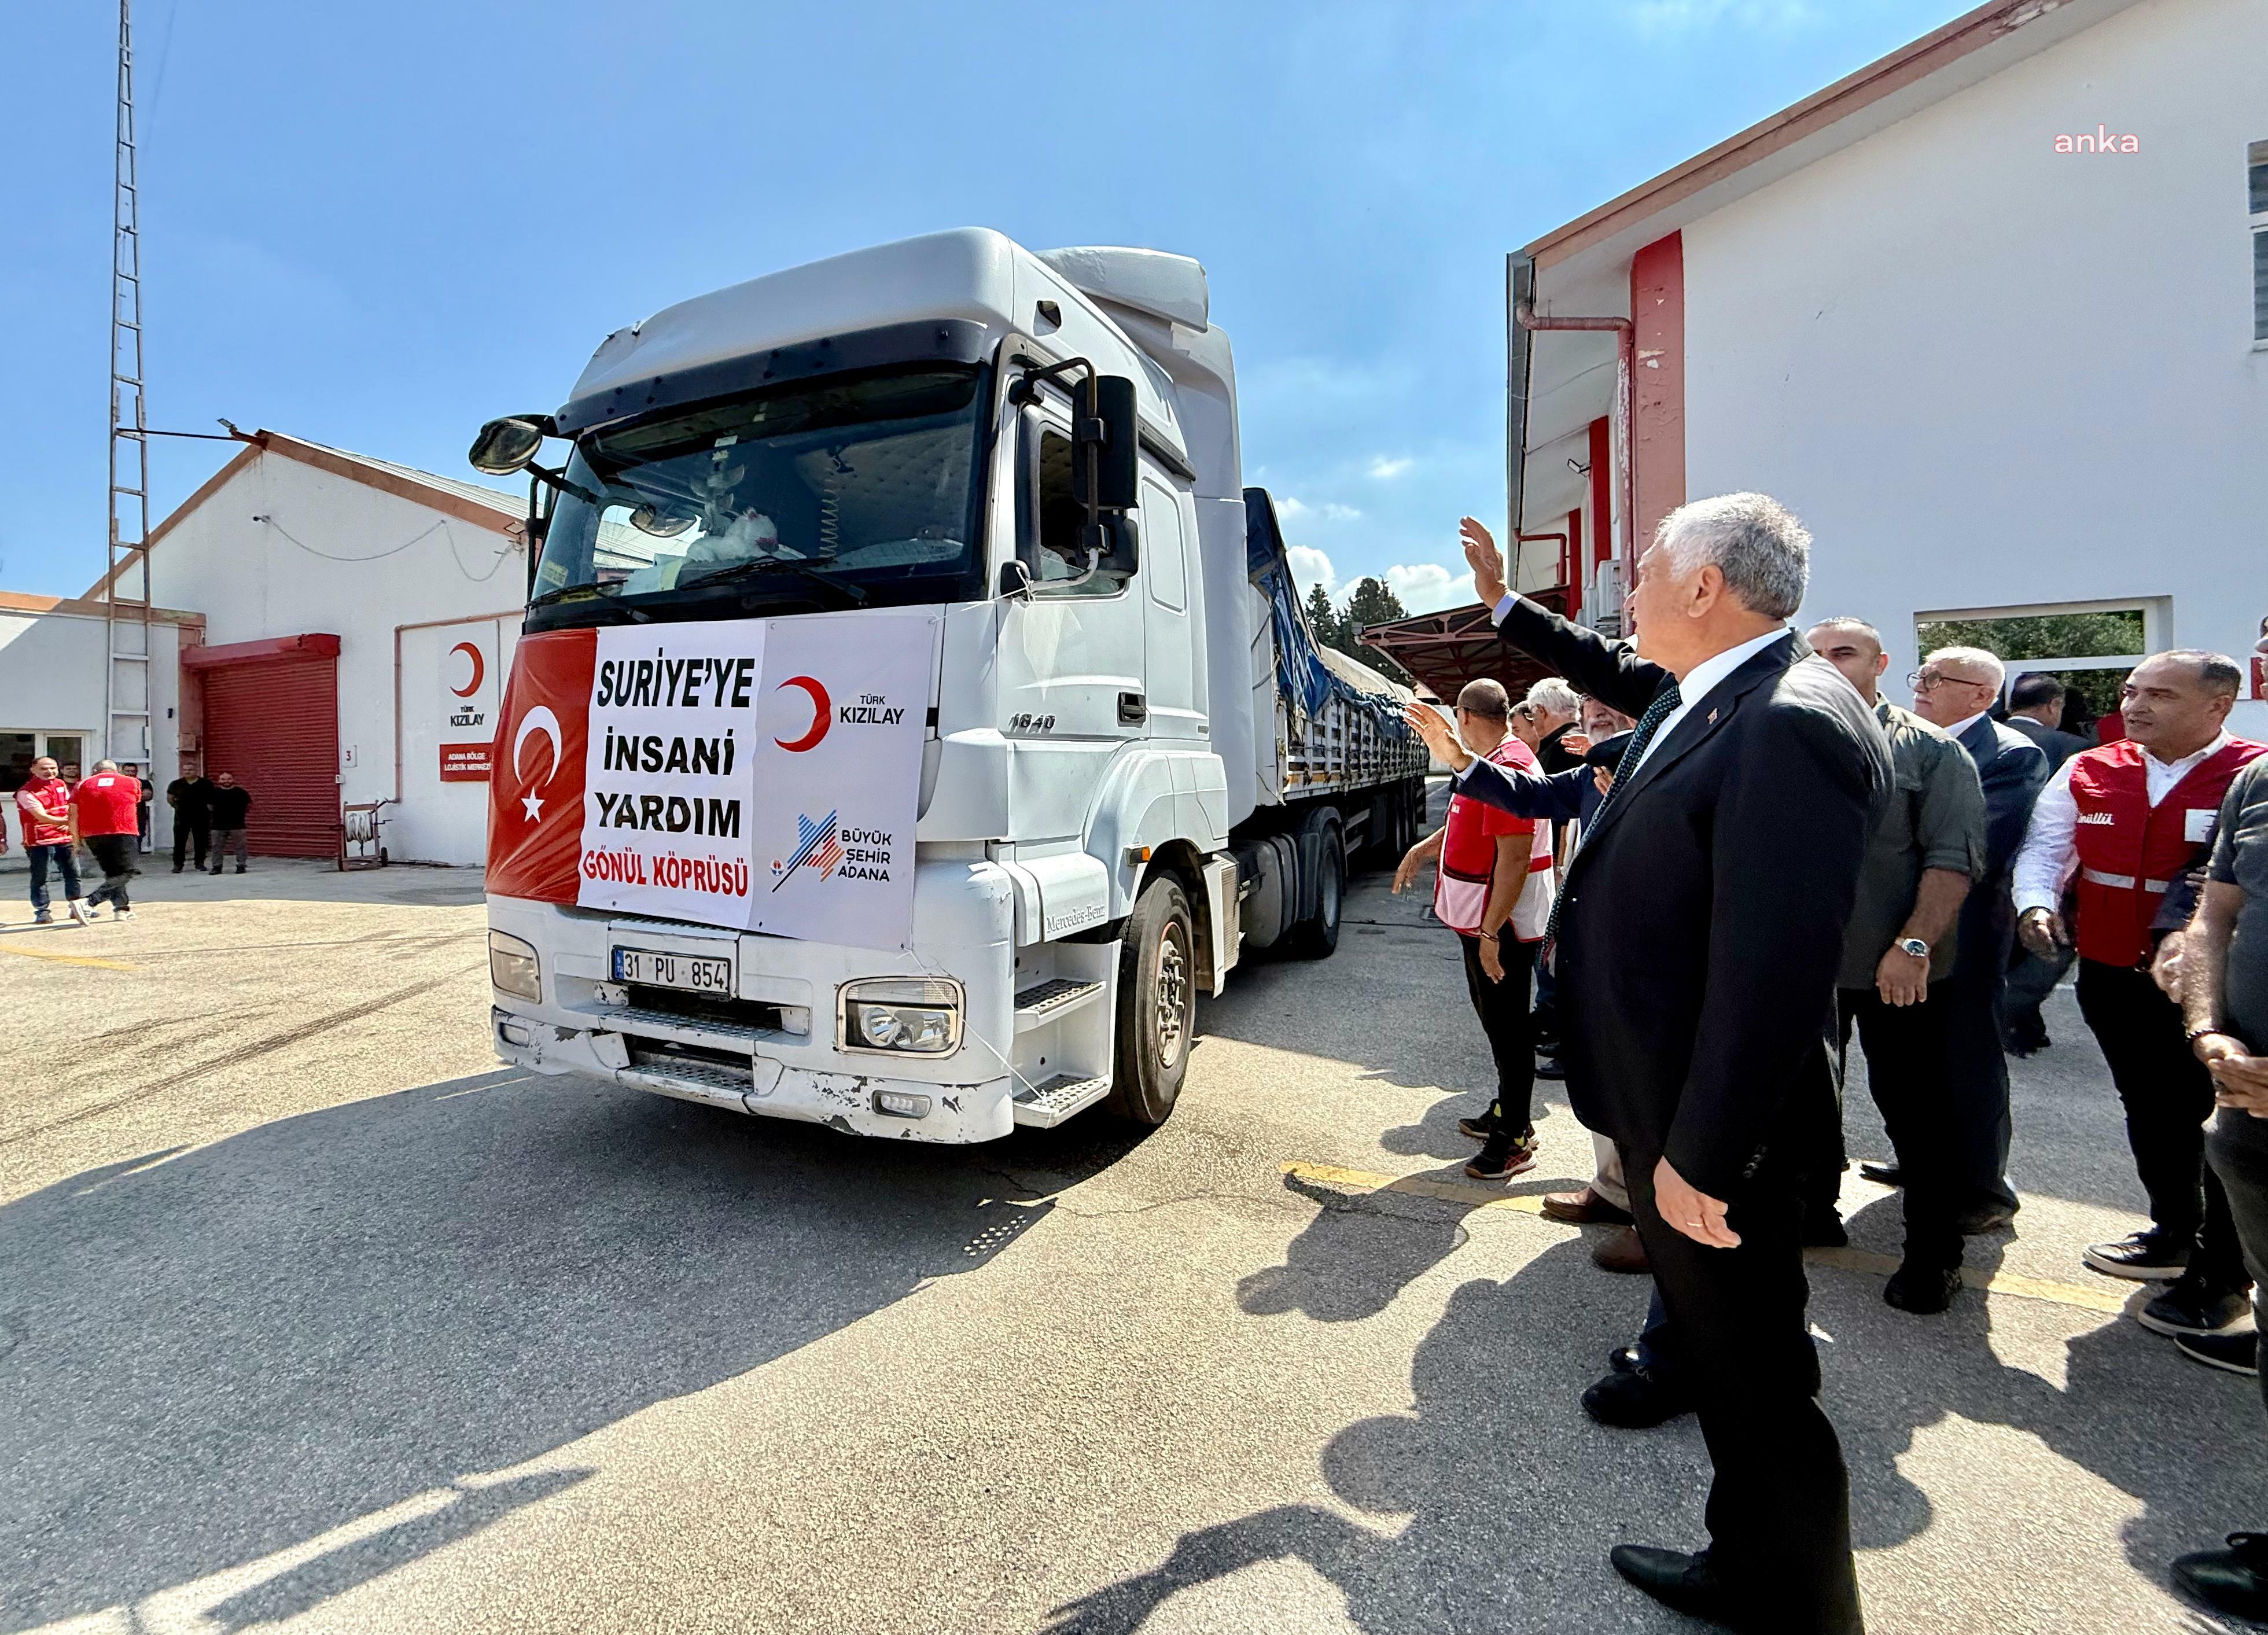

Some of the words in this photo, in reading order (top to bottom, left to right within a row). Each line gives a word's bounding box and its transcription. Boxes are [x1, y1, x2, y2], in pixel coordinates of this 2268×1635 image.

[597, 647, 755, 708] SURİYE'YE
[860, 694, 885, 705] TÜRK
[450, 713, 484, 727] KIZILAY
[840, 707, 905, 724] KIZILAY
[346, 750, 351, 761] 3
[466, 751, 485, 760] BÖLGE
[604, 726, 734, 775] İNSANİ
[594, 792, 740, 838] YARDIM
[842, 828, 892, 845] BÜYÜK
[846, 848, 890, 864] ŞEHİR
[583, 845, 647, 885] GÖNÜL
[653, 850, 748, 897] KÖPRÜSÜ
[838, 866, 889, 882] ADANA
[1046, 905, 1105, 933] Mercedes-Benz
[625, 953, 639, 978] 31
[656, 958, 675, 982] PU
[692, 962, 724, 989] 854
